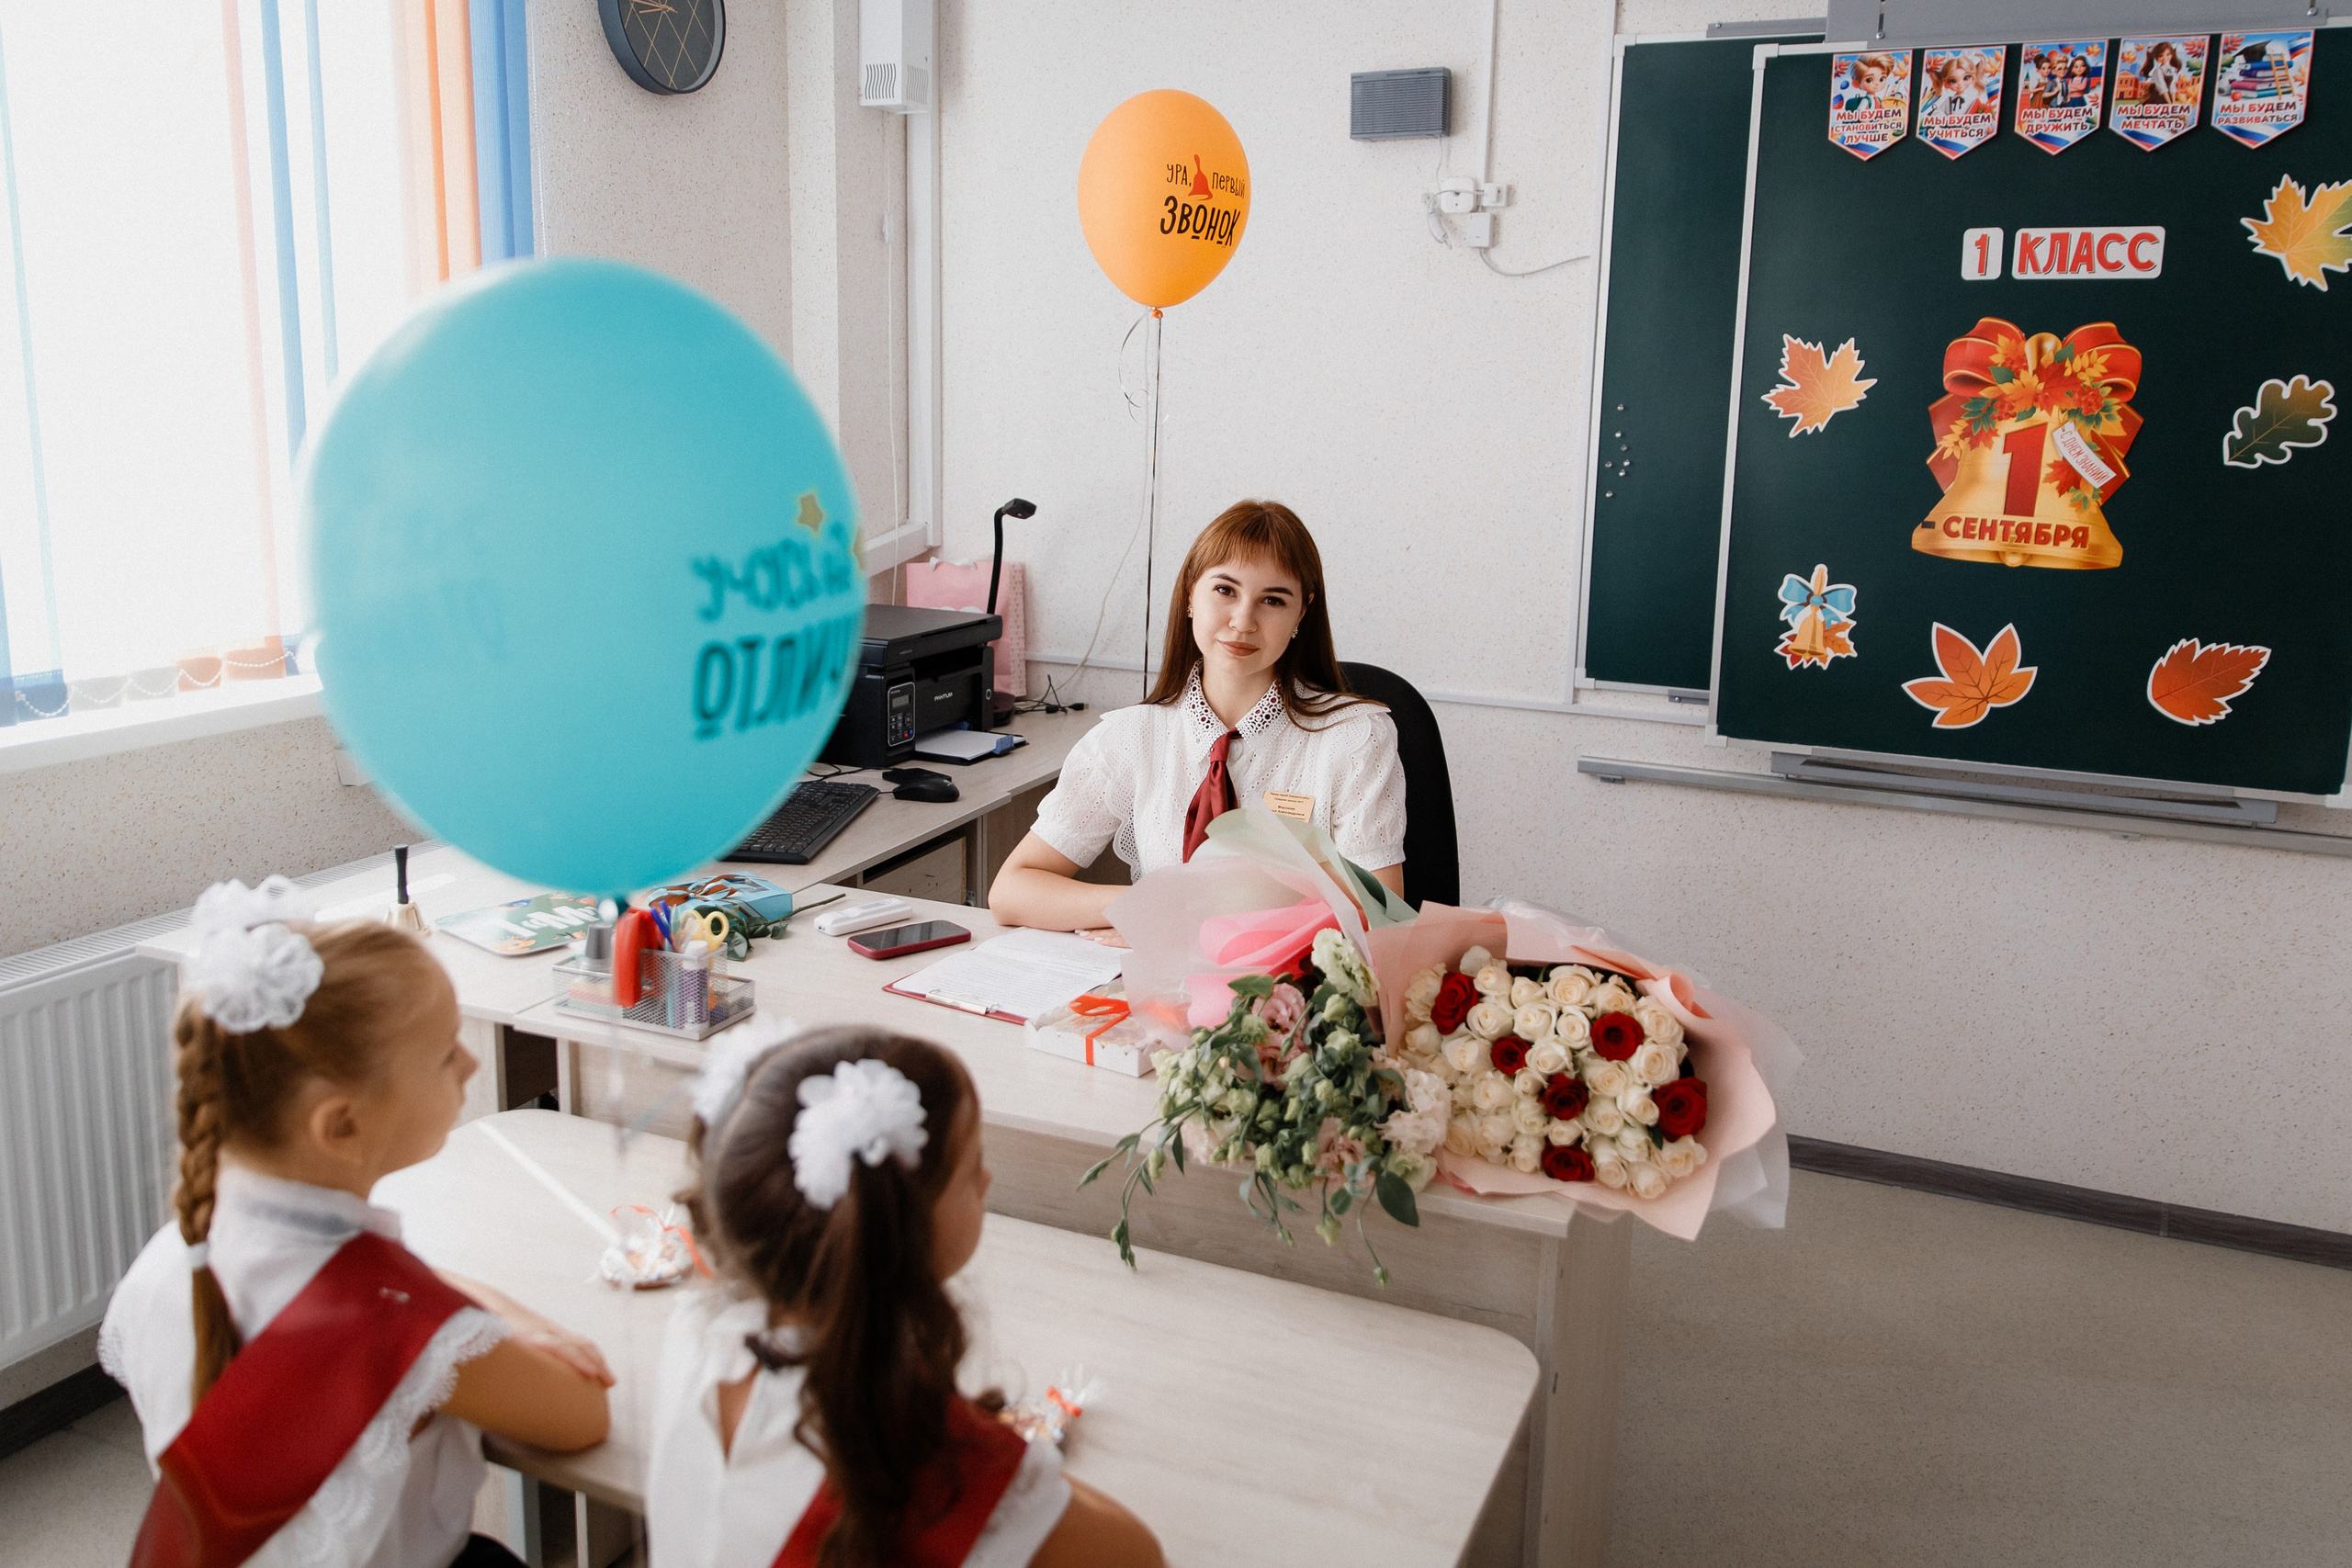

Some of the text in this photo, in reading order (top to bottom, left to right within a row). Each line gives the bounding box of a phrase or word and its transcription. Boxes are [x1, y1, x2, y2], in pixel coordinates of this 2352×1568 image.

[2022, 107, 2093, 119] МЫ БУДЕМ
[2117, 105, 2191, 116] МЫ БУДЕМ
[2220, 102, 2297, 114] МЫ БУДЕМ
[1837, 109, 1902, 121] МЫ БУДЕМ
[1923, 115, 1991, 126] МЫ БУДЕМ
[2217, 114, 2298, 125] РАЗВИВАТЬСЯ
[1835, 122, 1902, 132] СТАНОВИТЬСЯ
[2025, 121, 2088, 134] ДРУЖИТЬ
[2121, 118, 2182, 130] МЕЧТАТЬ
[1845, 133, 1888, 143] ЛУЧШЕ
[1928, 128, 1984, 139] УЧИТЬСЯ
[1166, 164, 1192, 187] УРА,
[1159, 196, 1240, 246] ЗВОНОК
[1975, 231, 2159, 276] 1 КЛАСС
[2060, 430, 2073, 439] С
[2061, 436, 2085, 459] ДНЕМ
[2002, 422, 2049, 517] 1
[1943, 516, 2089, 548] СЕНТЯБРЯ
